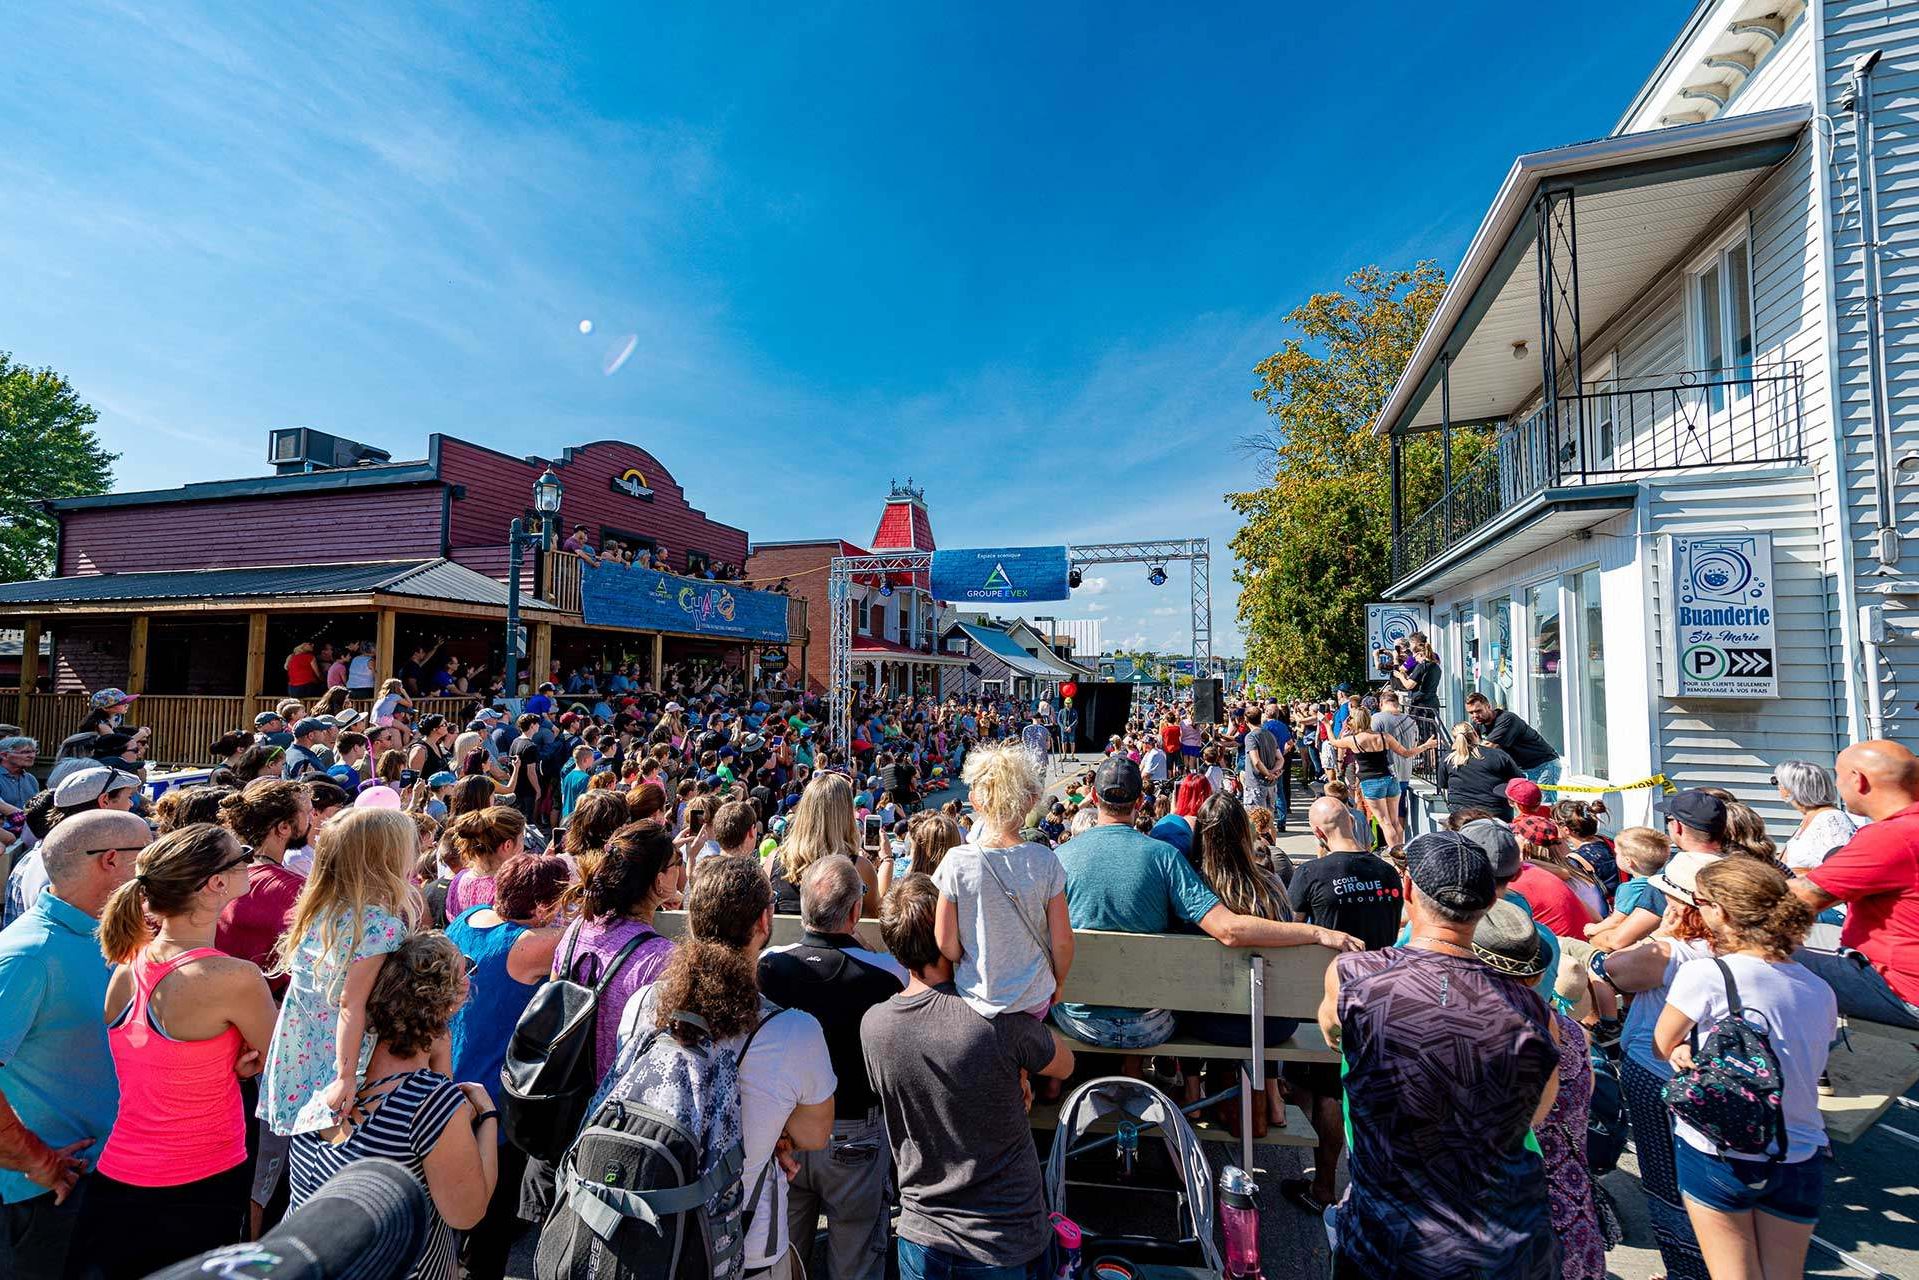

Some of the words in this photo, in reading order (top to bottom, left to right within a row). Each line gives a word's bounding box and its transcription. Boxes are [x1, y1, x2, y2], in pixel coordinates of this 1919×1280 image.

[966, 590, 1002, 598] GROUPE
[1680, 605, 1770, 626] Buanderie
[1694, 651, 1716, 674] P
[1334, 880, 1382, 895] CIRQUE
